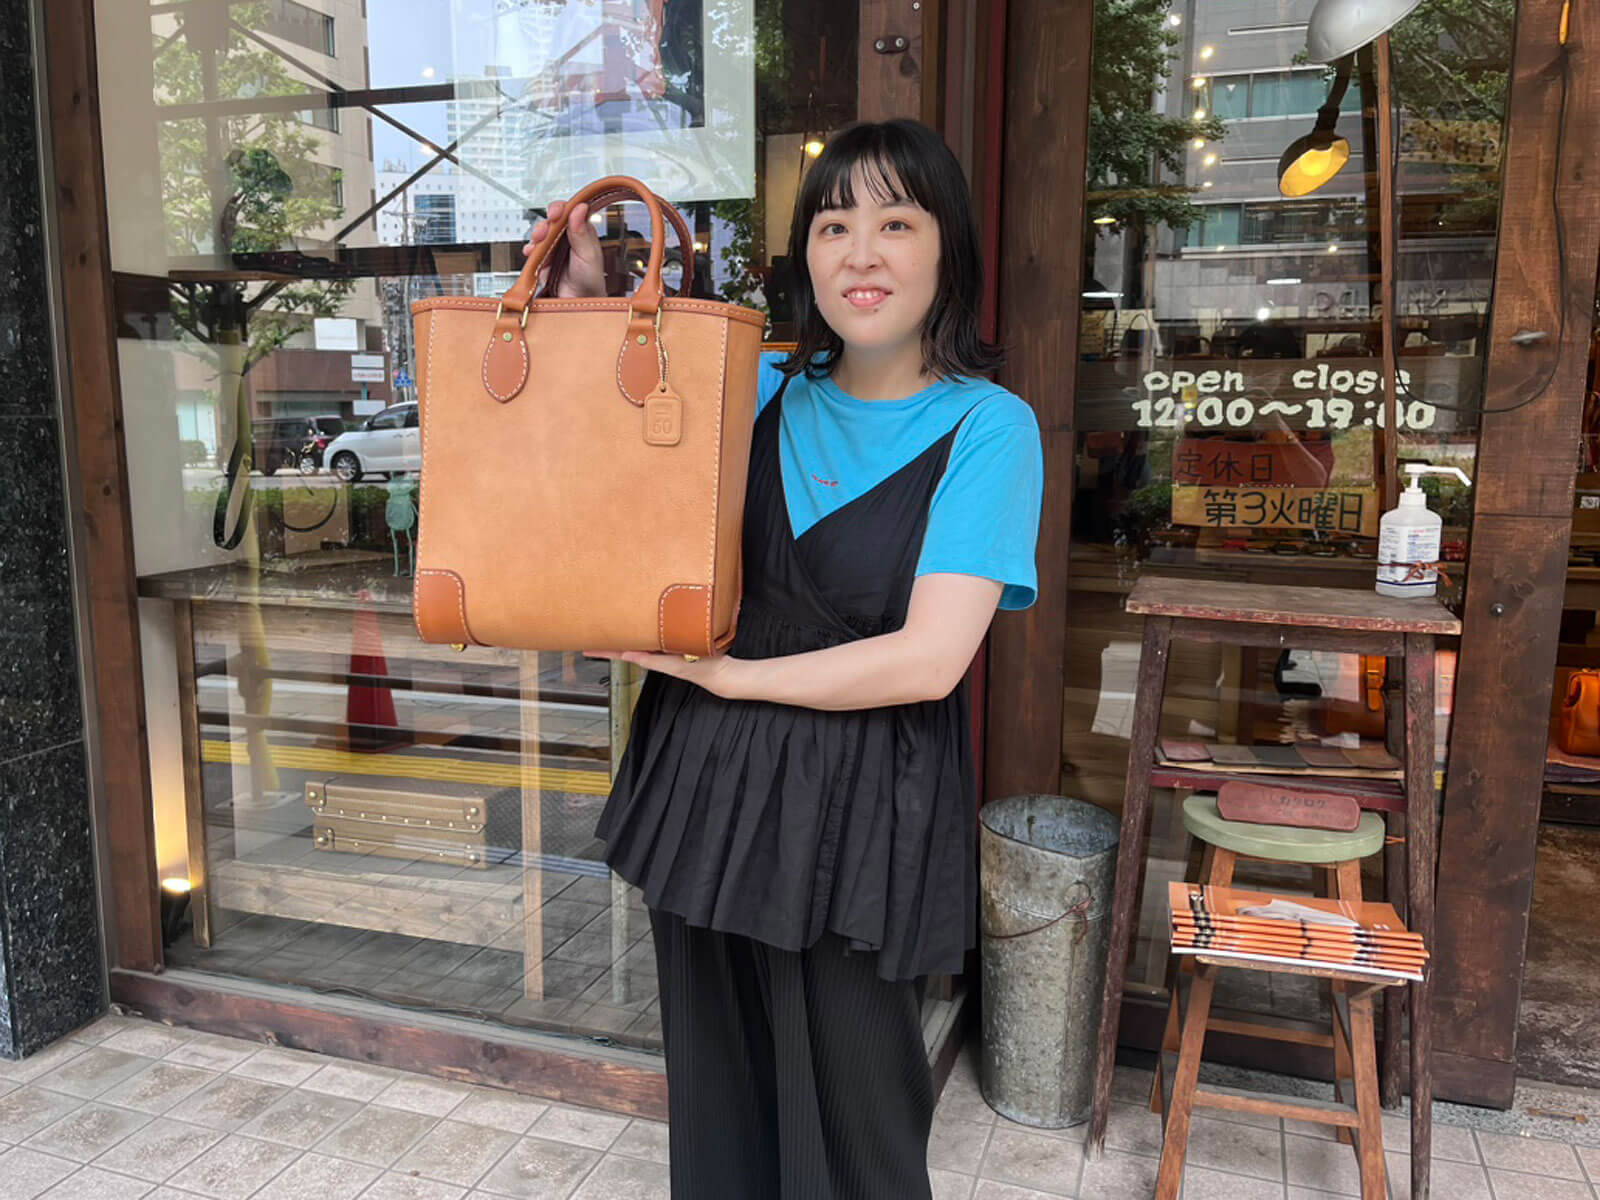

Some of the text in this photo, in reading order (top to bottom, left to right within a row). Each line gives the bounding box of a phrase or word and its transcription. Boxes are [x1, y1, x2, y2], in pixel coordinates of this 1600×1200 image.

[1143, 364, 1410, 394] open close
[1177, 449, 1273, 482] 定休日
[1203, 489, 1364, 532] 第3火曜日
